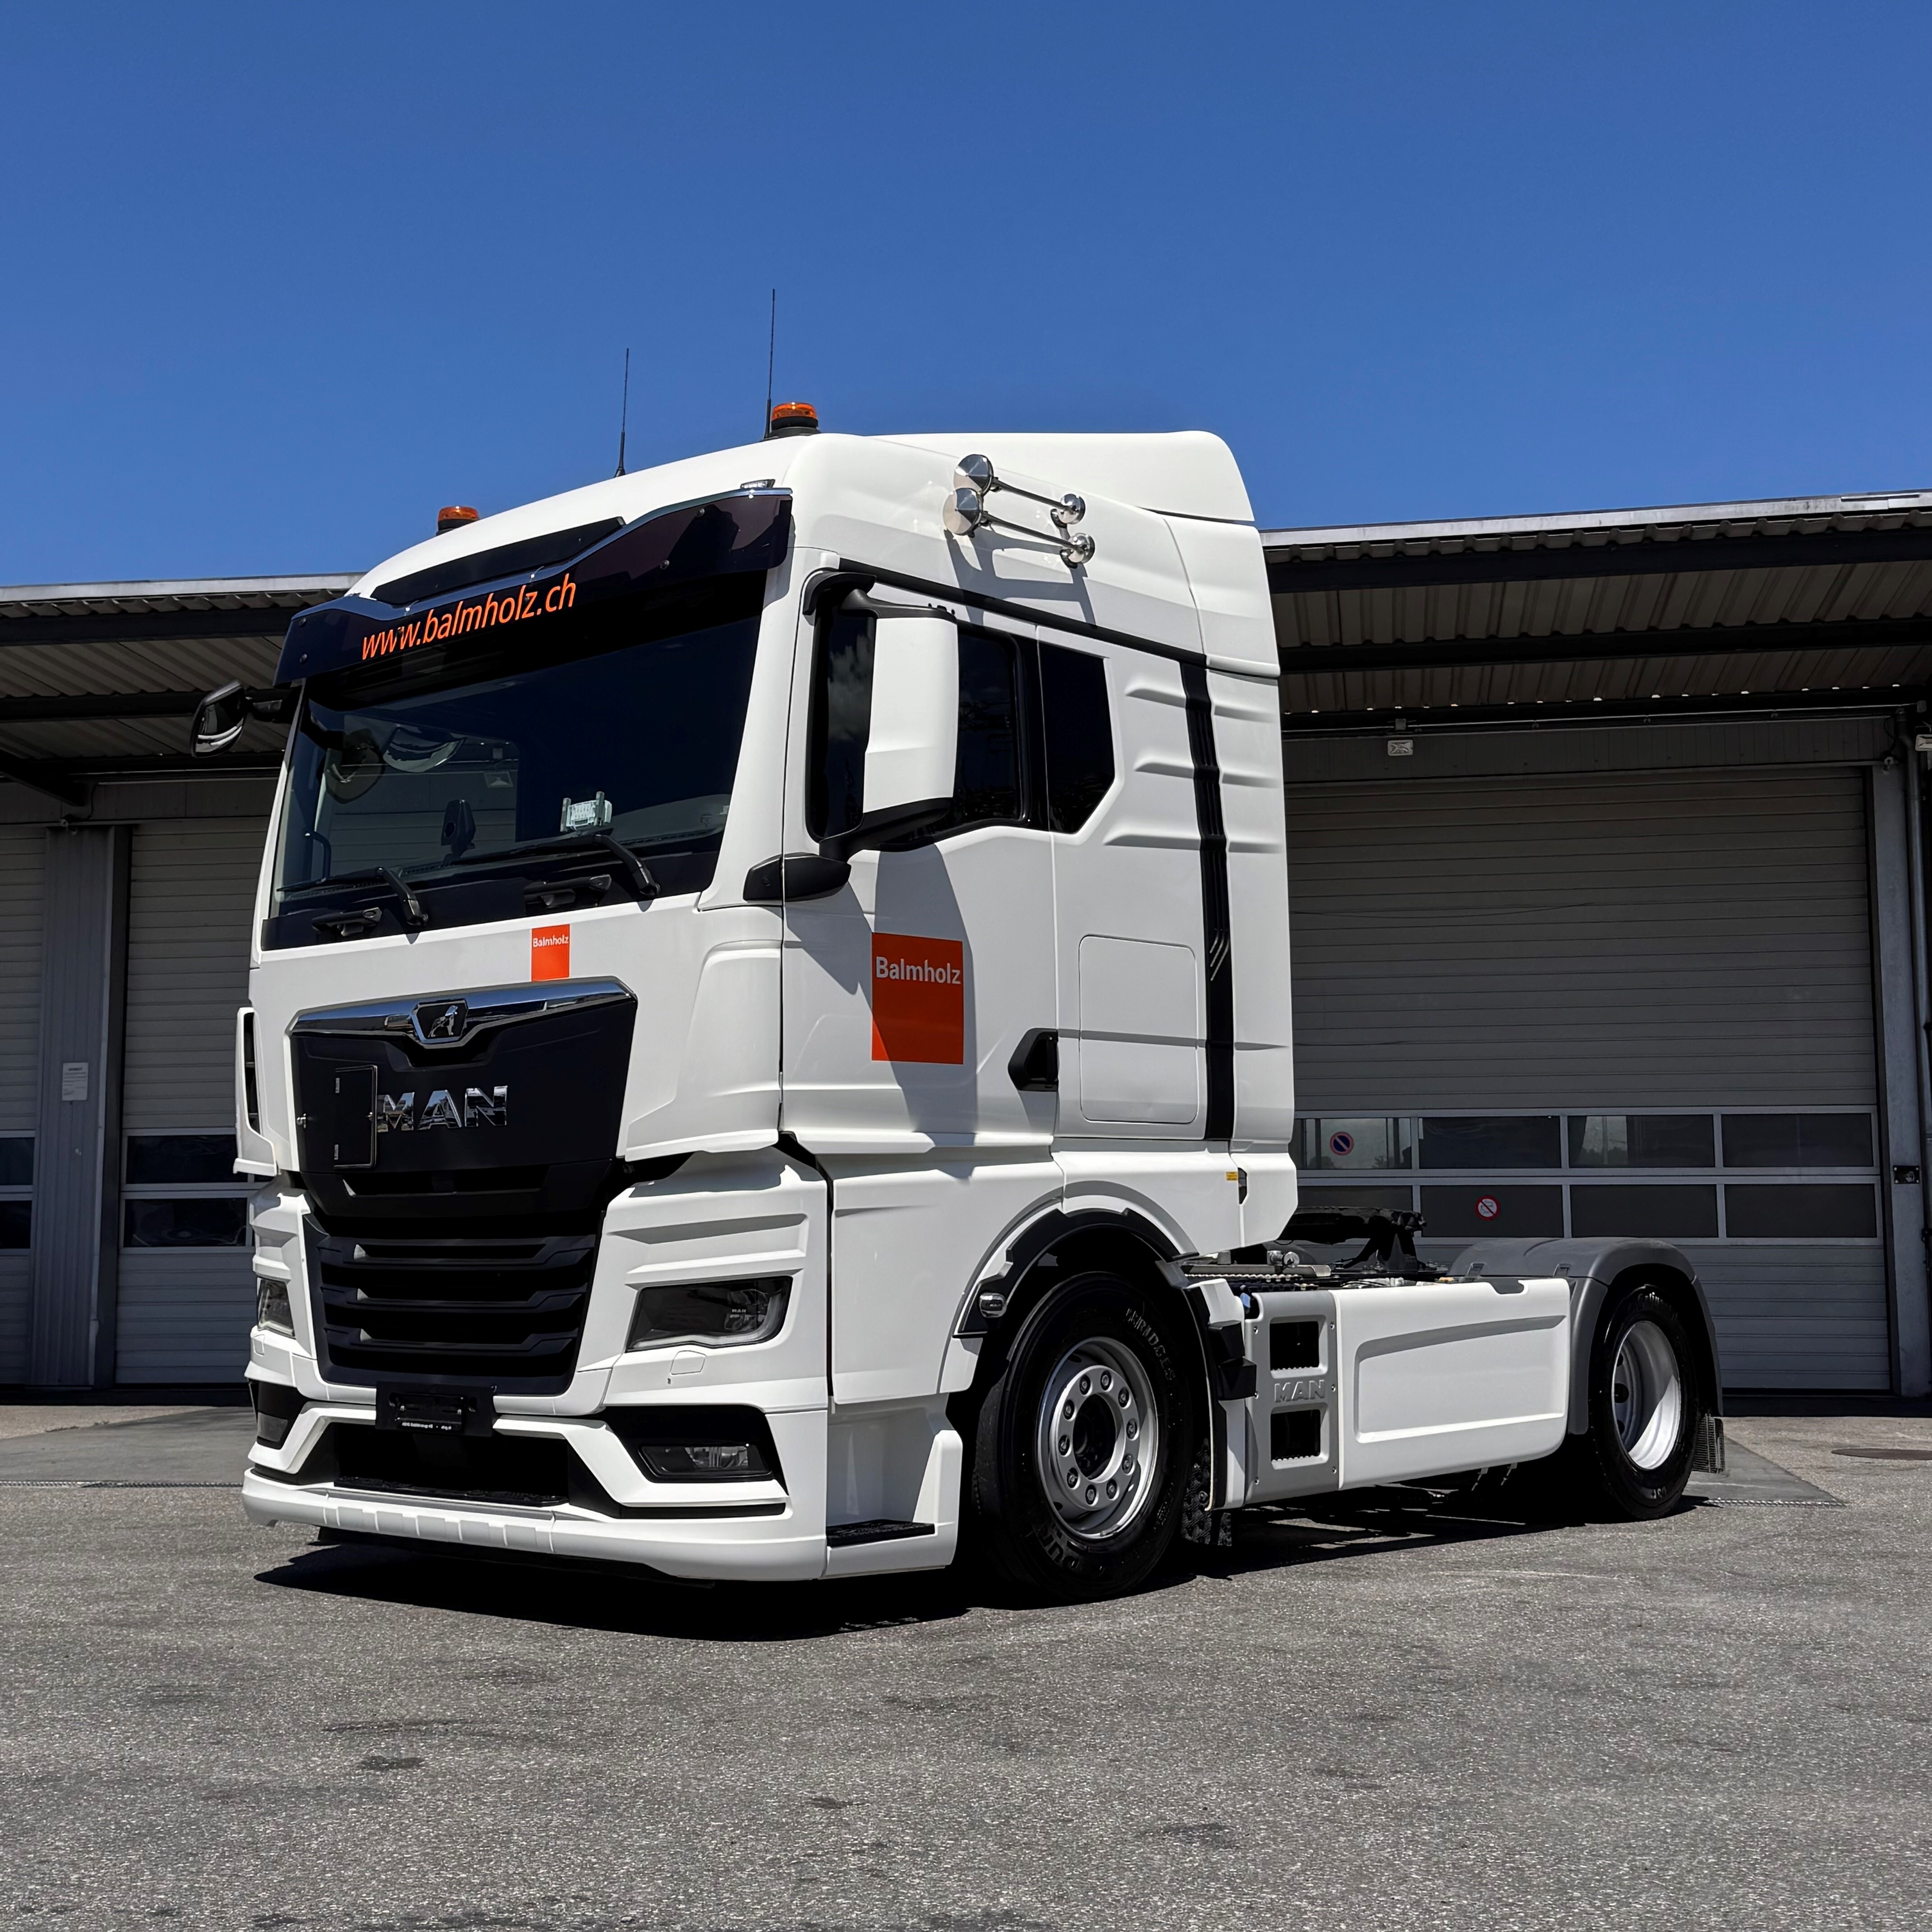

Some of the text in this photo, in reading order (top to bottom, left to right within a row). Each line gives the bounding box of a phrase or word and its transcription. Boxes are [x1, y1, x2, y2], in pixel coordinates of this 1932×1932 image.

[362, 573, 576, 660] www.balmholz.ch
[533, 934, 569, 948] Balmholz
[876, 956, 961, 984] Balmholz
[377, 1085, 508, 1132] MAN
[1274, 1379, 1325, 1403] MAN
